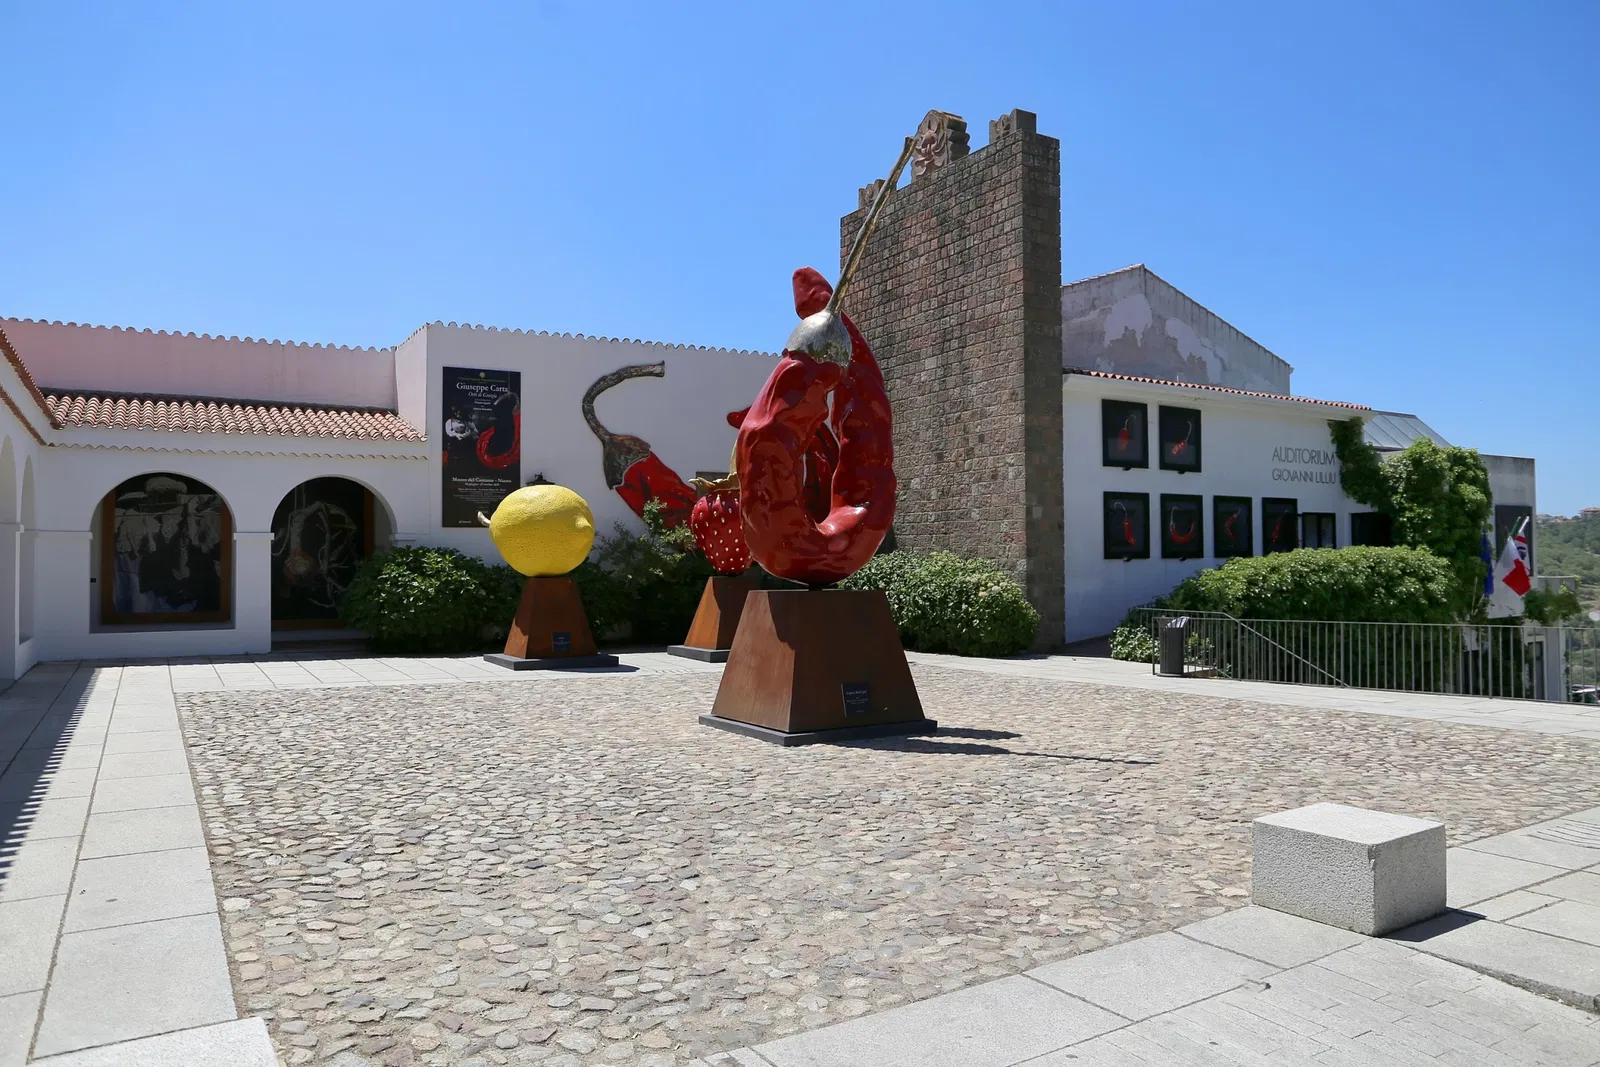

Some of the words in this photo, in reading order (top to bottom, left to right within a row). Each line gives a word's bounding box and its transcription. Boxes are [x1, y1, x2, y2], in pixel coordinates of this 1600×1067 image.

[456, 382, 489, 393] Giuseppe
[490, 384, 508, 392] Carta
[1272, 446, 1335, 465] AUDITORIUM
[1272, 468, 1313, 482] GIOVANNI
[1316, 472, 1336, 484] LILLIU
